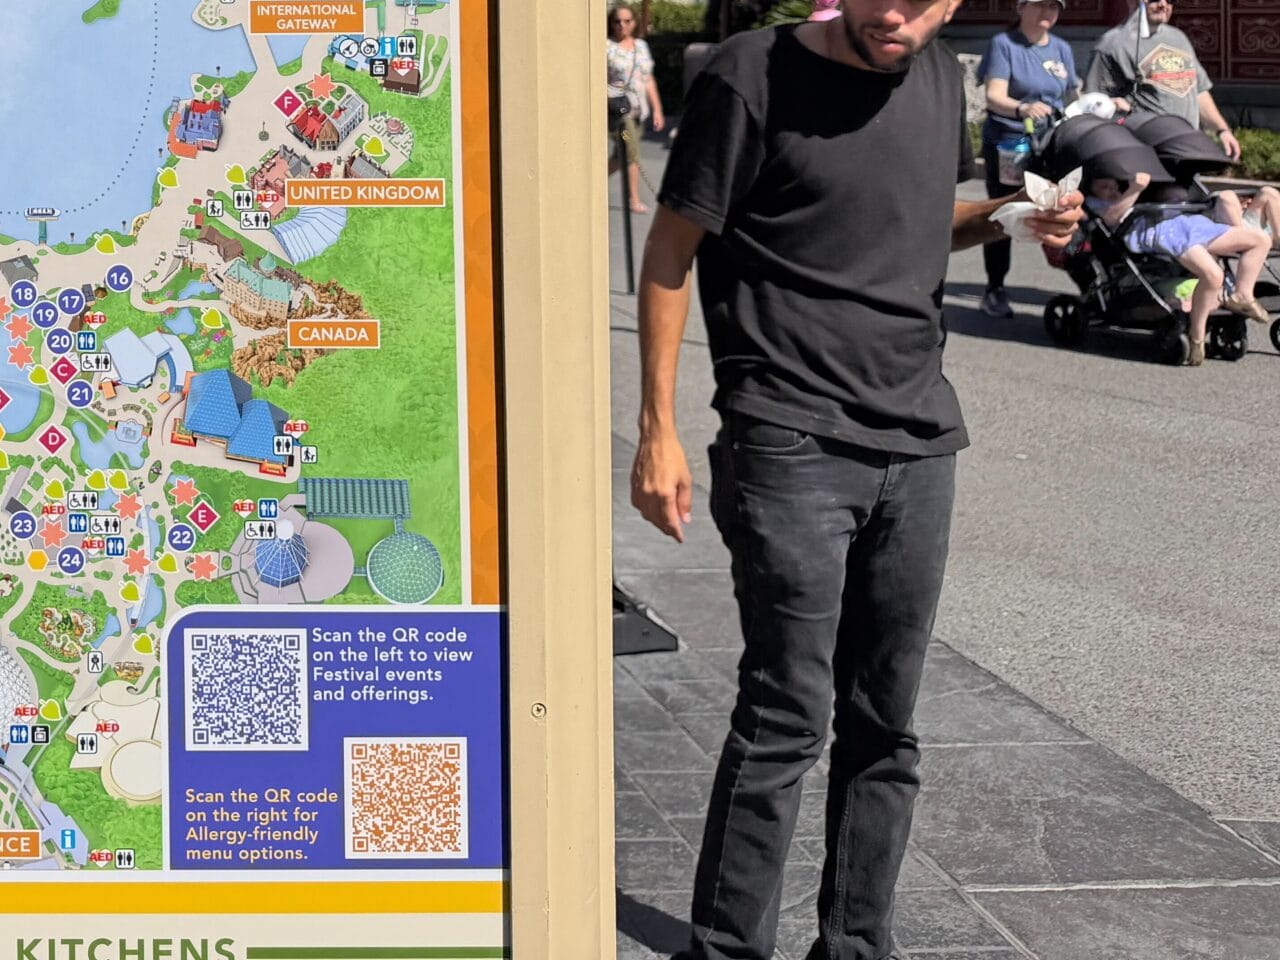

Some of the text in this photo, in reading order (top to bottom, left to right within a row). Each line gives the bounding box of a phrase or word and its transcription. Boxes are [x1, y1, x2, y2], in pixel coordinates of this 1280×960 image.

[257, 4, 357, 16] INTERNATIONAL
[276, 18, 337, 30] GATEWAY
[392, 61, 415, 70] AED
[283, 96, 293, 109] F
[256, 193, 279, 202] AED
[290, 185, 440, 201] UNITED KINGDOM
[110, 272, 129, 285] 16
[15, 287, 34, 301] 18
[61, 295, 80, 309] 17
[36, 308, 55, 322] 19
[50, 334, 70, 348] 20
[298, 326, 369, 342] CANADA
[56, 363, 68, 377] C
[71, 387, 89, 401] 21
[284, 423, 309, 432] AED
[48, 432, 60, 446] D
[42, 505, 65, 514] AED
[233, 503, 256, 512] AED
[197, 509, 207, 523] E
[13, 519, 33, 533] 23
[172, 530, 191, 544] 22
[82, 540, 104, 549] AED
[61, 553, 81, 567] 24
[312, 626, 468, 643] Scan the QR code
[312, 646, 473, 662] on the left to view
[313, 665, 443, 682] Festival events
[313, 685, 434, 705] and offerings.
[15, 708, 38, 717] AED
[96, 723, 120, 732] AED
[185, 787, 338, 803] Scan the QR code
[185, 806, 319, 826] on the right for
[185, 825, 319, 845] Allergy-friendly
[90, 852, 113, 862] AED
[186, 845, 308, 864] menu options.
[16, 937, 236, 960] KITCHENS
